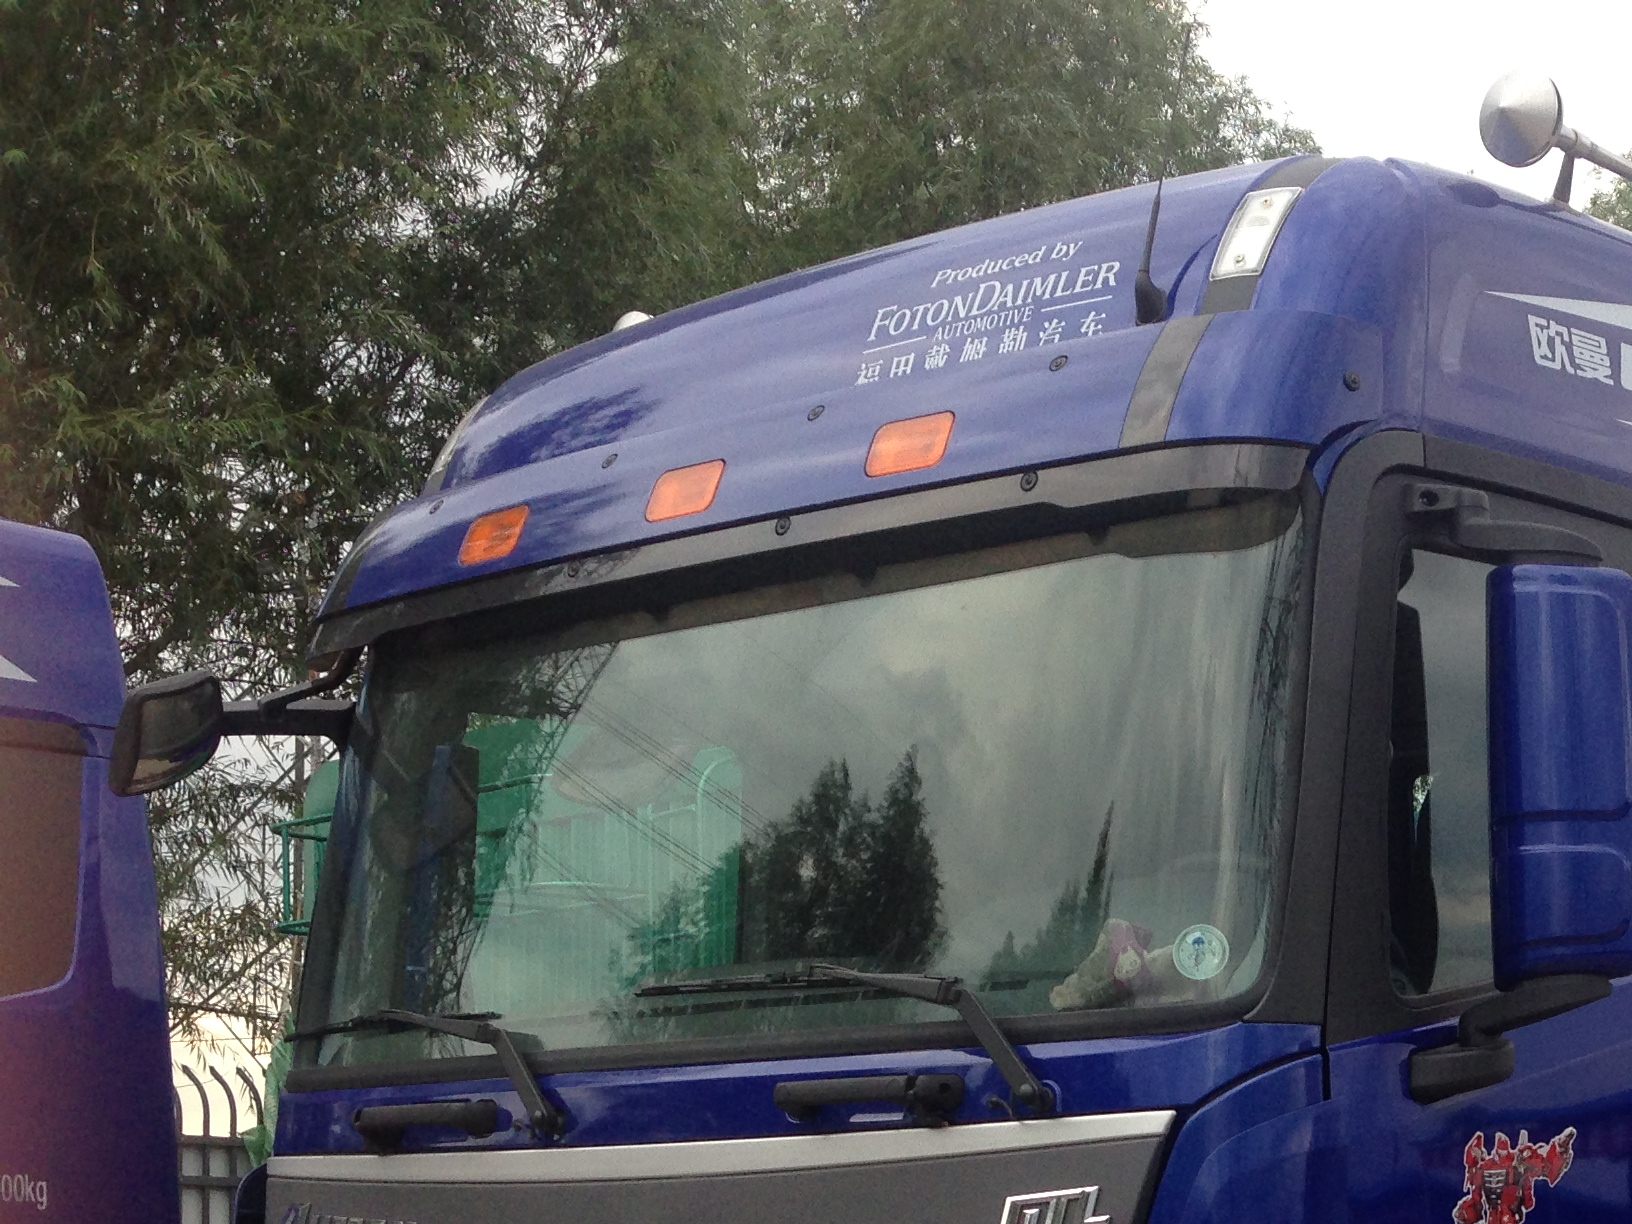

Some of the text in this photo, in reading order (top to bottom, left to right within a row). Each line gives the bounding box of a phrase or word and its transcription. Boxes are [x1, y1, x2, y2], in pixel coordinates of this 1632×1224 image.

[931, 240, 1083, 288] Produced by
[931, 306, 1034, 342] AUTOMOTIVE
[1527, 313, 1614, 386] 欧曼
